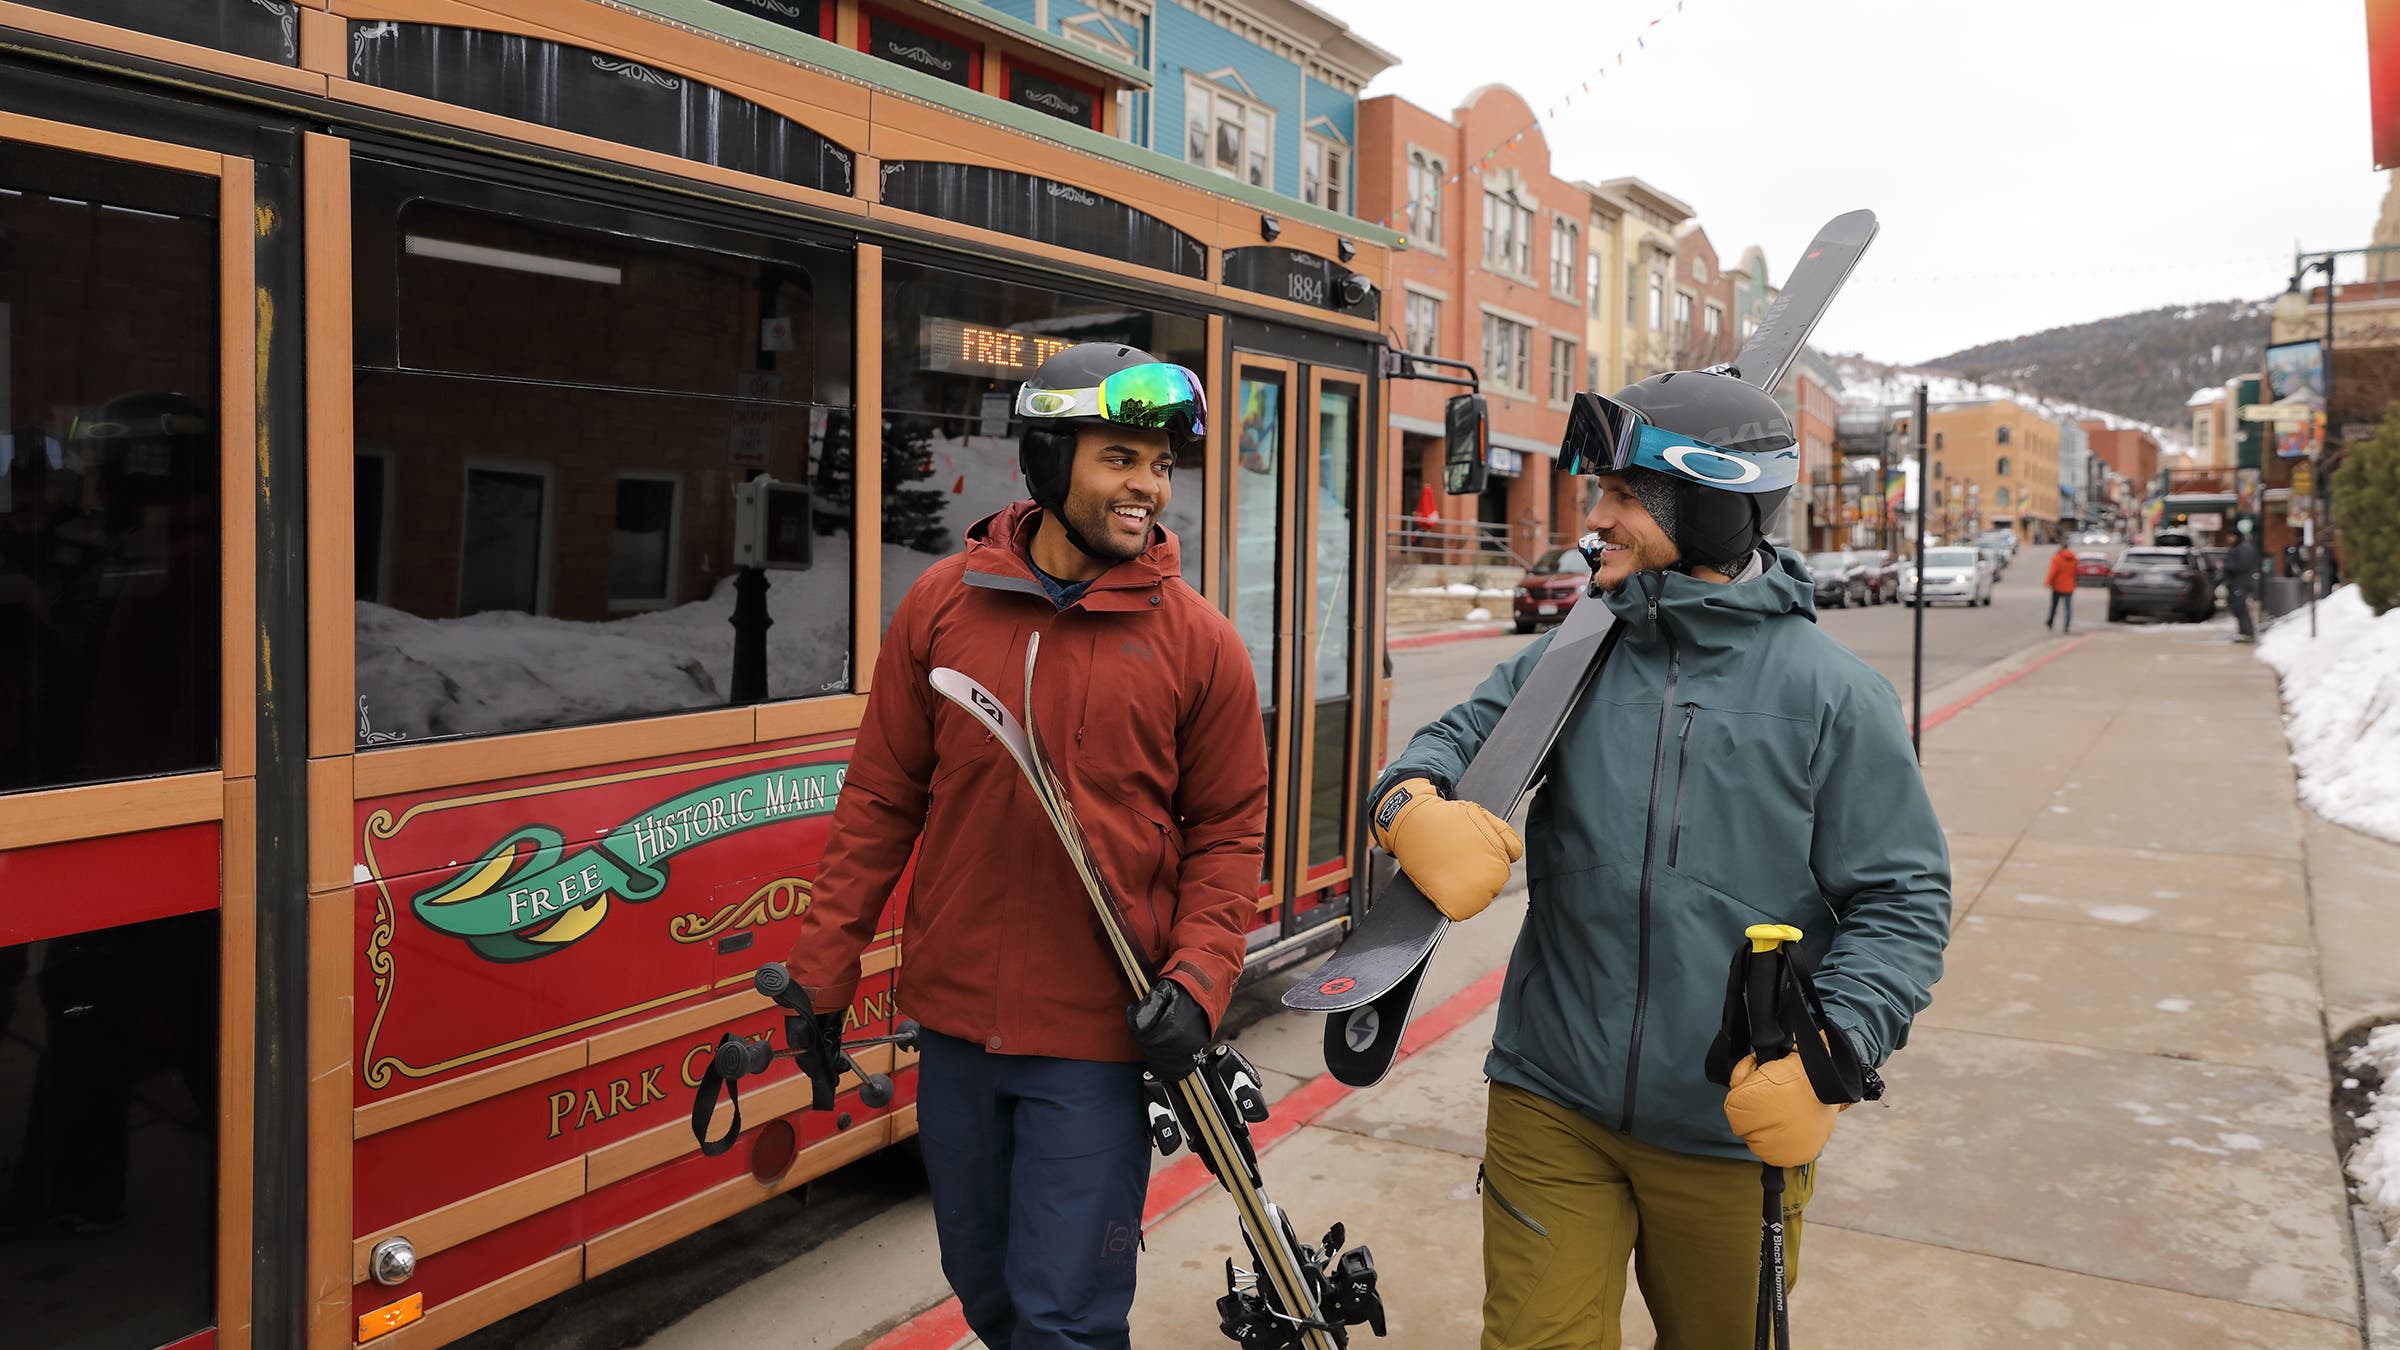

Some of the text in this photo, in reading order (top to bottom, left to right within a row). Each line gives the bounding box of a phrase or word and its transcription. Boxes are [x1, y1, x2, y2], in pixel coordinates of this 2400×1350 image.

[1288, 272, 1323, 305] 1884
[963, 327, 1024, 367] FREE
[508, 864, 603, 926] FREE
[633, 788, 754, 866] HISTORIC
[764, 774, 827, 818] MAIN
[547, 1065, 667, 1139] PARK
[1772, 1234, 1783, 1264] Black
